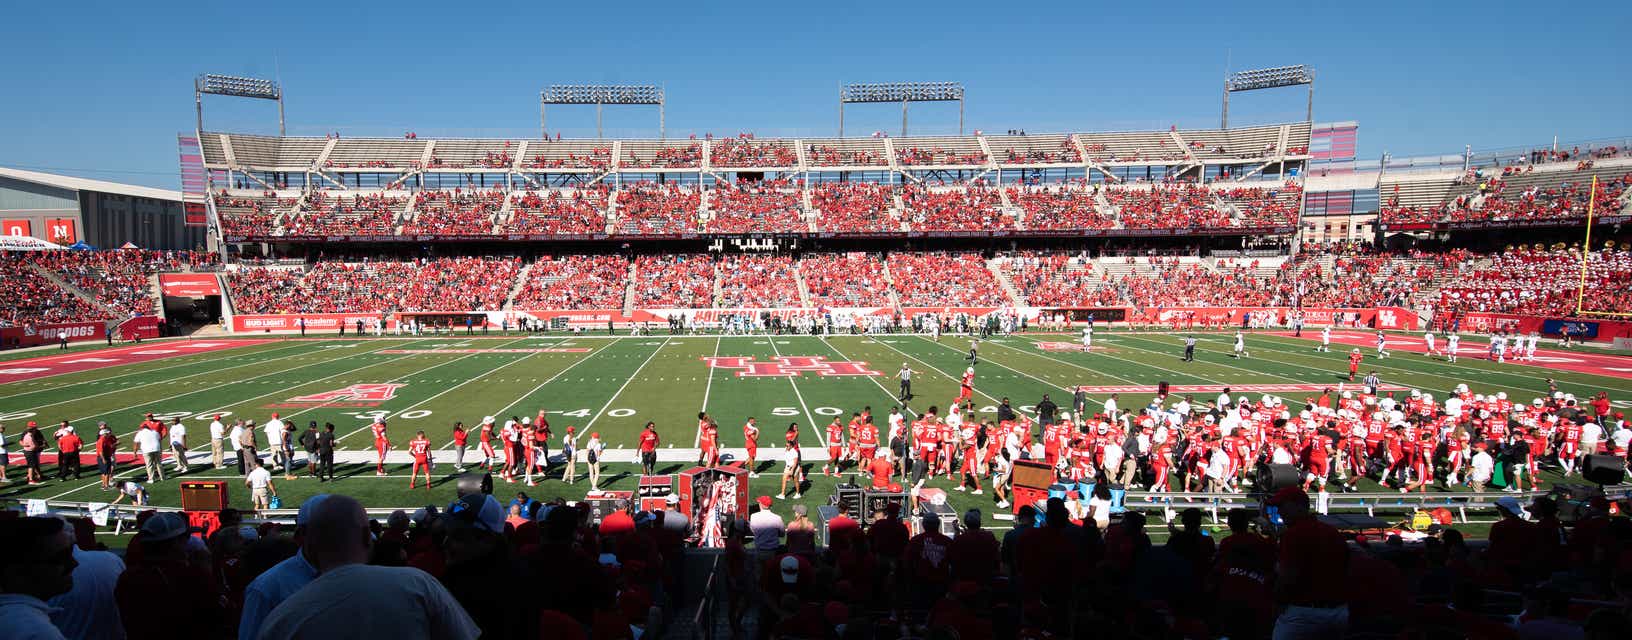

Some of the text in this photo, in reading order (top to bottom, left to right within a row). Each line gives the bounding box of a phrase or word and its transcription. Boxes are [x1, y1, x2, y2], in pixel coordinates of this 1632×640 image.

[563, 408, 637, 418] 40
[771, 406, 843, 416] 50
[926, 428, 937, 439] 75
[1370, 424, 1382, 434] 60
[1492, 424, 1504, 434] 89
[861, 430, 872, 440] 53
[1046, 430, 1056, 441] 70
[415, 443, 426, 454] 47
[1312, 439, 1320, 450] 71
